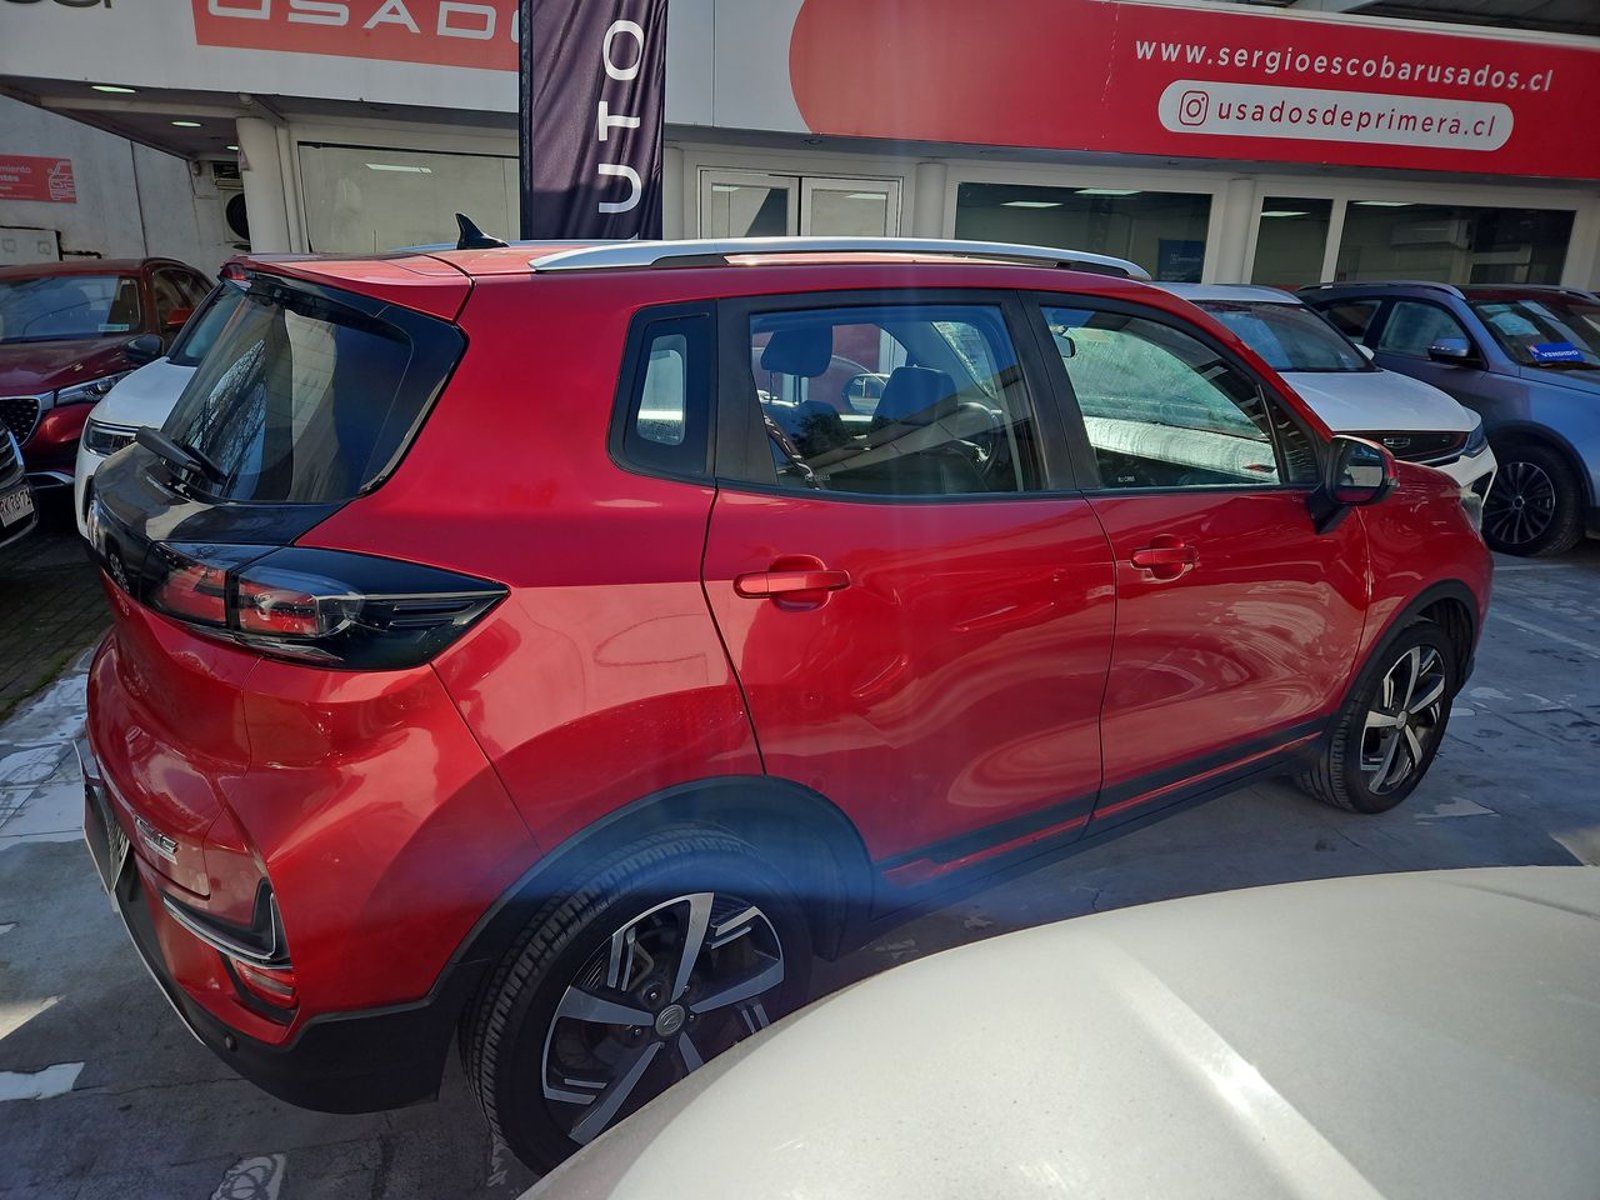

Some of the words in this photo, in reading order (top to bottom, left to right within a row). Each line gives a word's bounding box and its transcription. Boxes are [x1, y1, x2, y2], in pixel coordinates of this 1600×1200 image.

[208, 0, 519, 43] USAD
[1135, 40, 1553, 92] www.sergioescobarusados.cl
[599, 20, 644, 240] UTO
[1217, 99, 1496, 138] usadosdeprimera.cl
